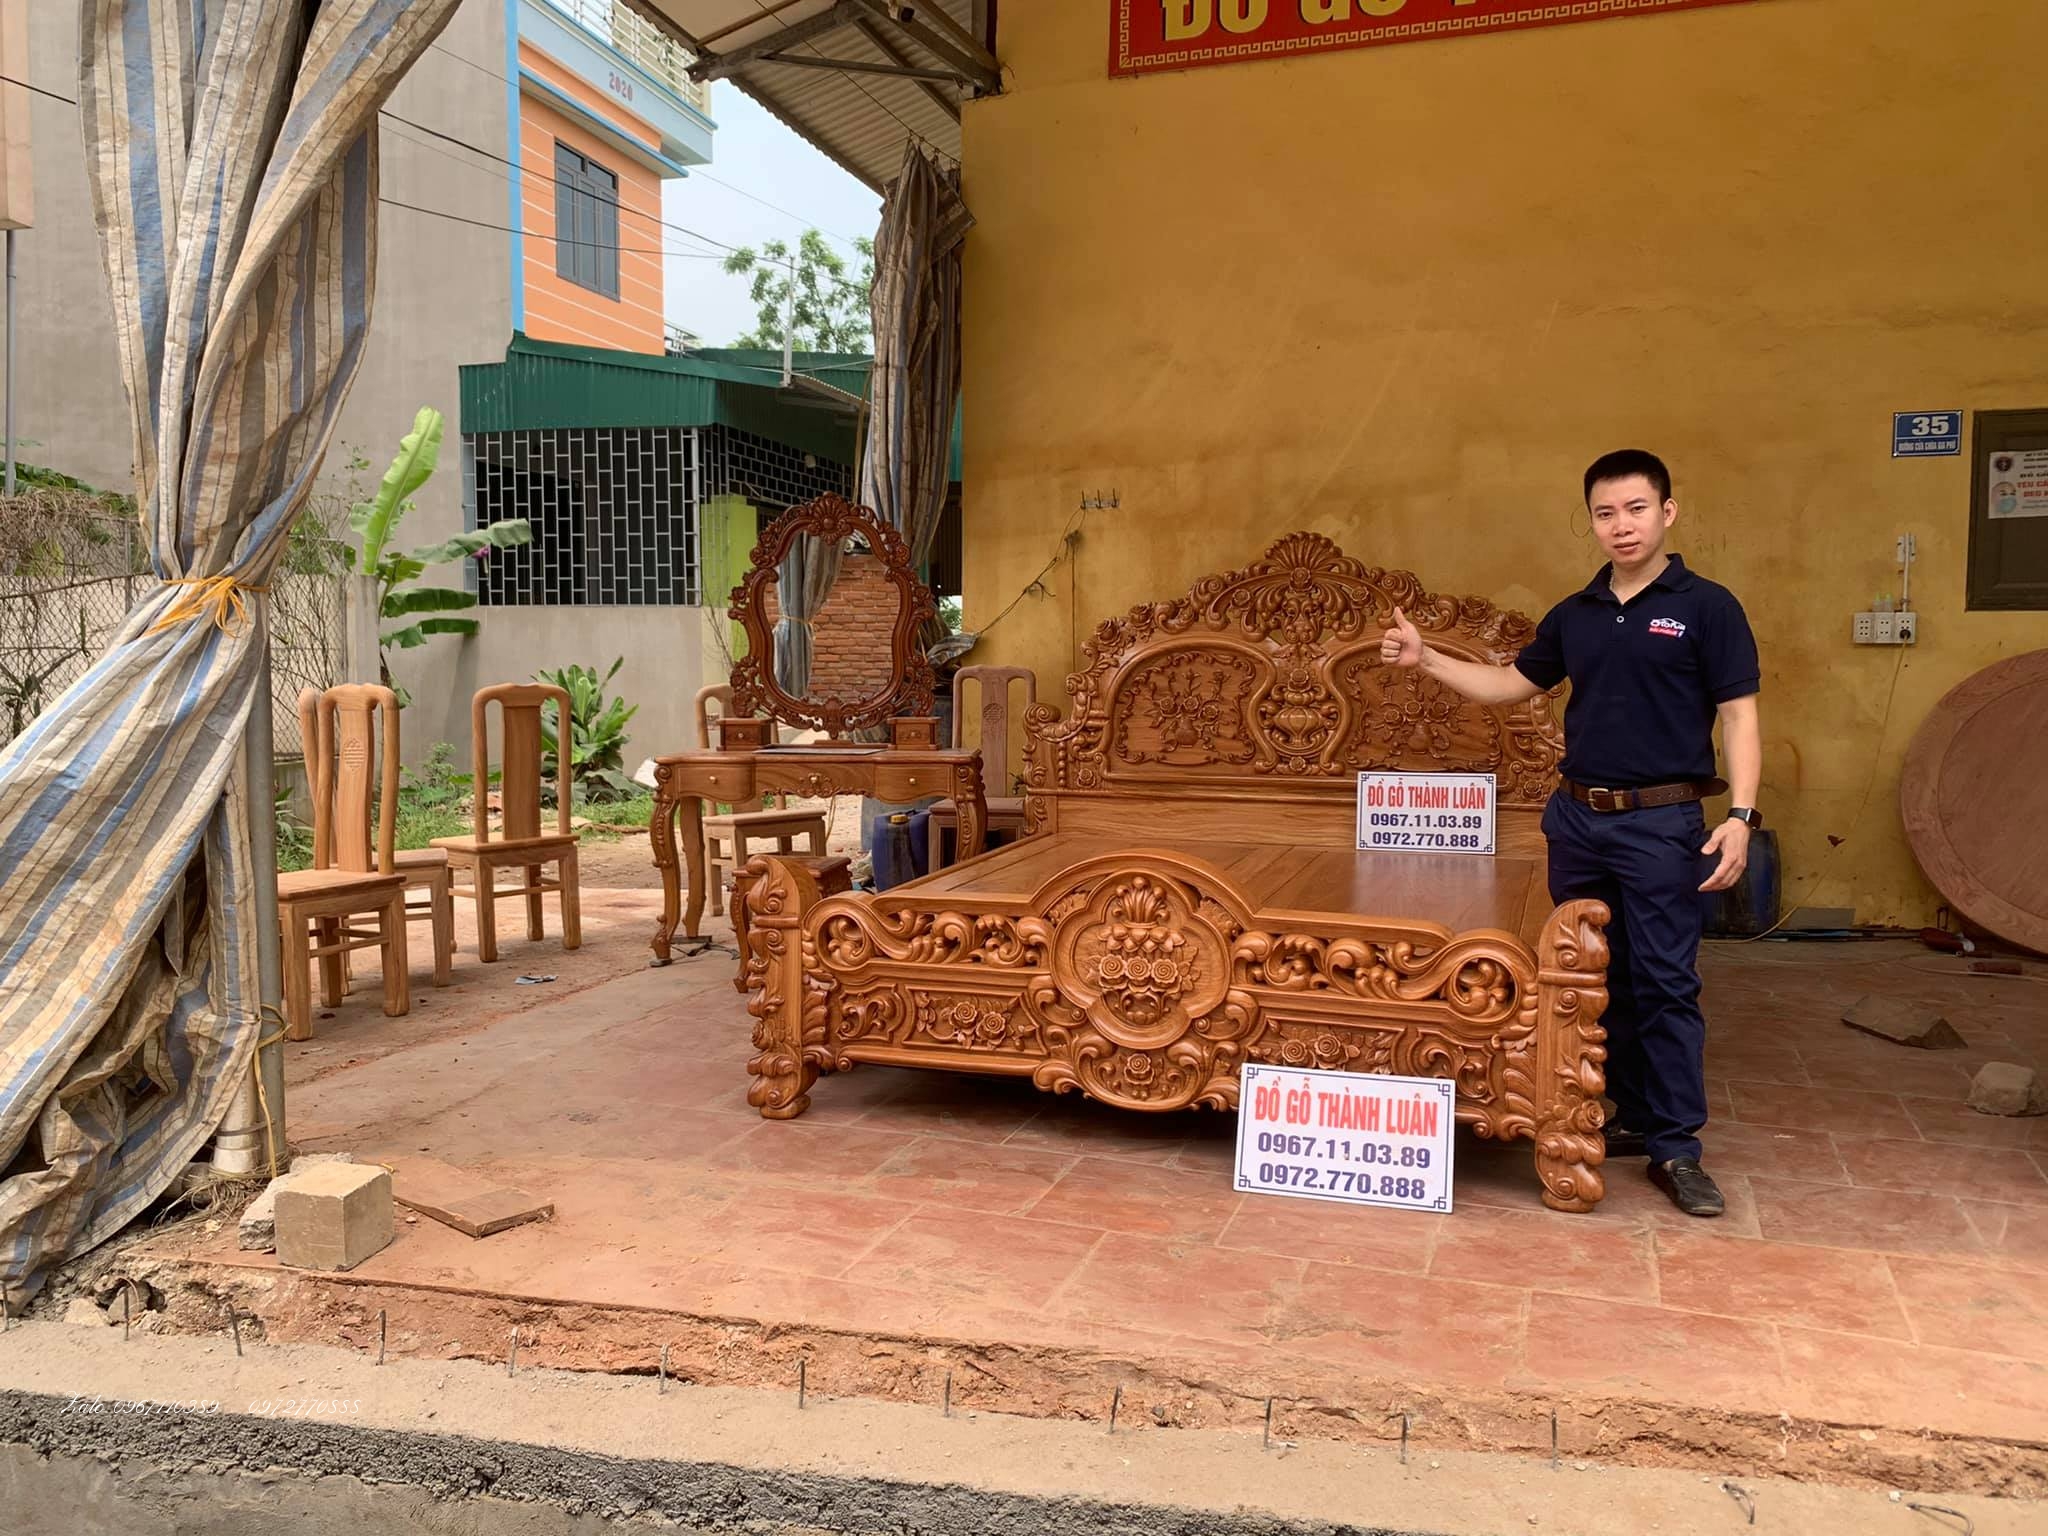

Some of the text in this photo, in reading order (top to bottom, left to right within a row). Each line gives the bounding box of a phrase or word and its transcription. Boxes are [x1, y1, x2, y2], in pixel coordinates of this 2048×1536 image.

[609, 71, 633, 101] 2020
[1912, 416, 1949, 435] 35
[1368, 777, 1486, 809] ĐỒ GỖ THÀNH LUÂN
[1370, 812, 1482, 829] 0967.11.03.89
[1372, 831, 1479, 848] 0972.770.888
[1255, 1076, 1438, 1137] ĐỒ GỖ THÀNH LUÂN
[1258, 1132, 1431, 1169] 0967.11.03.89
[1259, 1163, 1426, 1200] 0972.770.888
